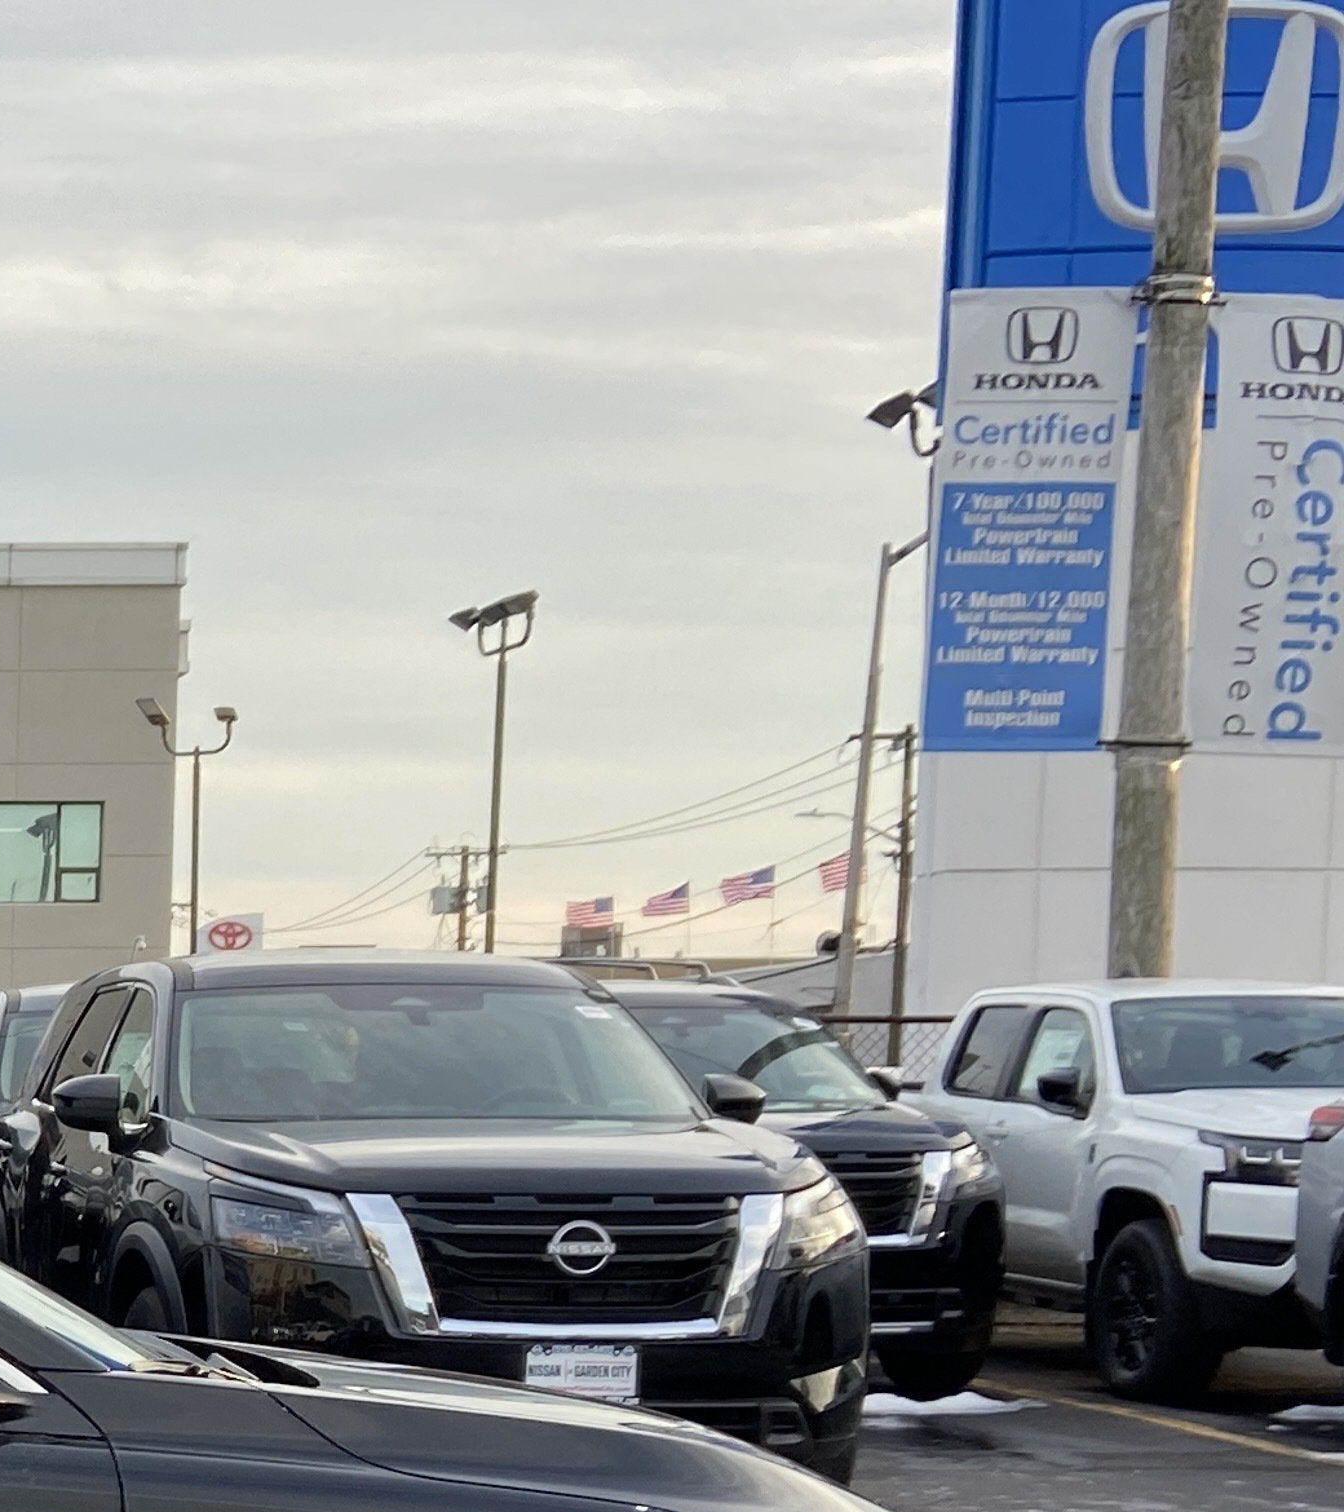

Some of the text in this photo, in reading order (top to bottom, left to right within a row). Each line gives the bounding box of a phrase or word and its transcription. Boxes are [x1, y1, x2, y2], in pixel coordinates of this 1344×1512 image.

[973, 373, 1102, 390] HONDA
[1239, 382, 1344, 402] HOND
[954, 413, 1116, 446] Certified
[952, 450, 1112, 469] Pre-Owned
[1223, 440, 1289, 737] Pre-Owned
[1266, 438, 1344, 741] Certified
[547, 1241, 616, 1255] NISSAN
